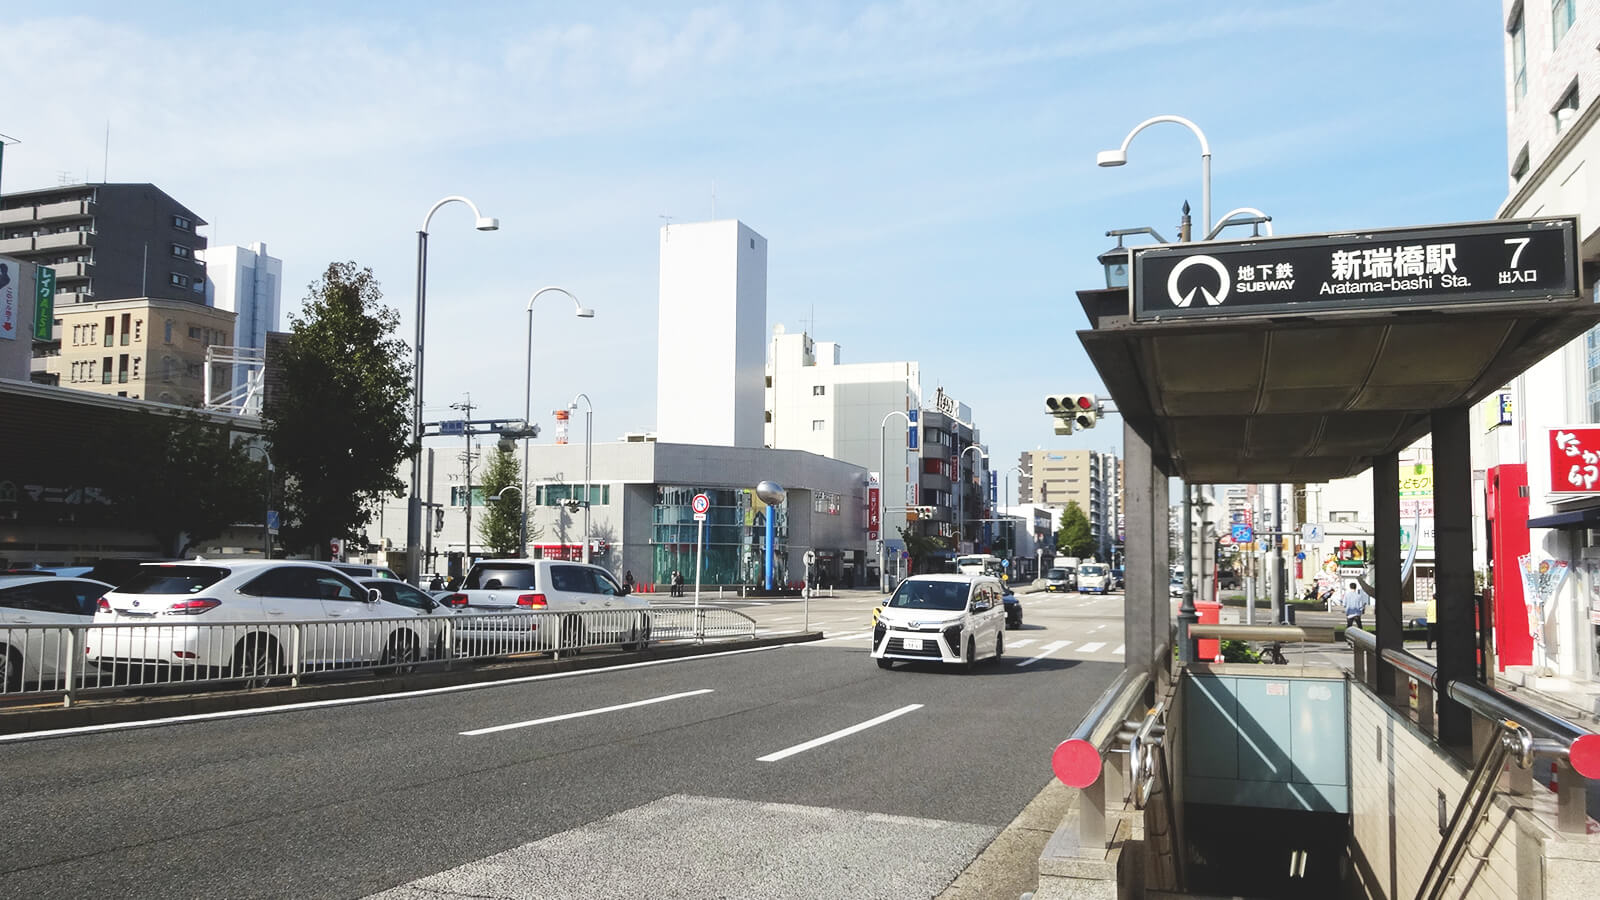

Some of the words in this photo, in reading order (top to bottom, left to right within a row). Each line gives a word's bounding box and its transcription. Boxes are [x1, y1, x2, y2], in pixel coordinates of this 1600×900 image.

[1331, 243, 1458, 281] 新瑞橋駅
[1504, 238, 1531, 269] 7
[1237, 262, 1294, 281] 地下鉄
[1498, 269, 1537, 285] 出入口
[1236, 279, 1296, 293] SUBWAY
[1319, 276, 1433, 295] Aratama-bashi
[1440, 274, 1472, 289] Sta.
